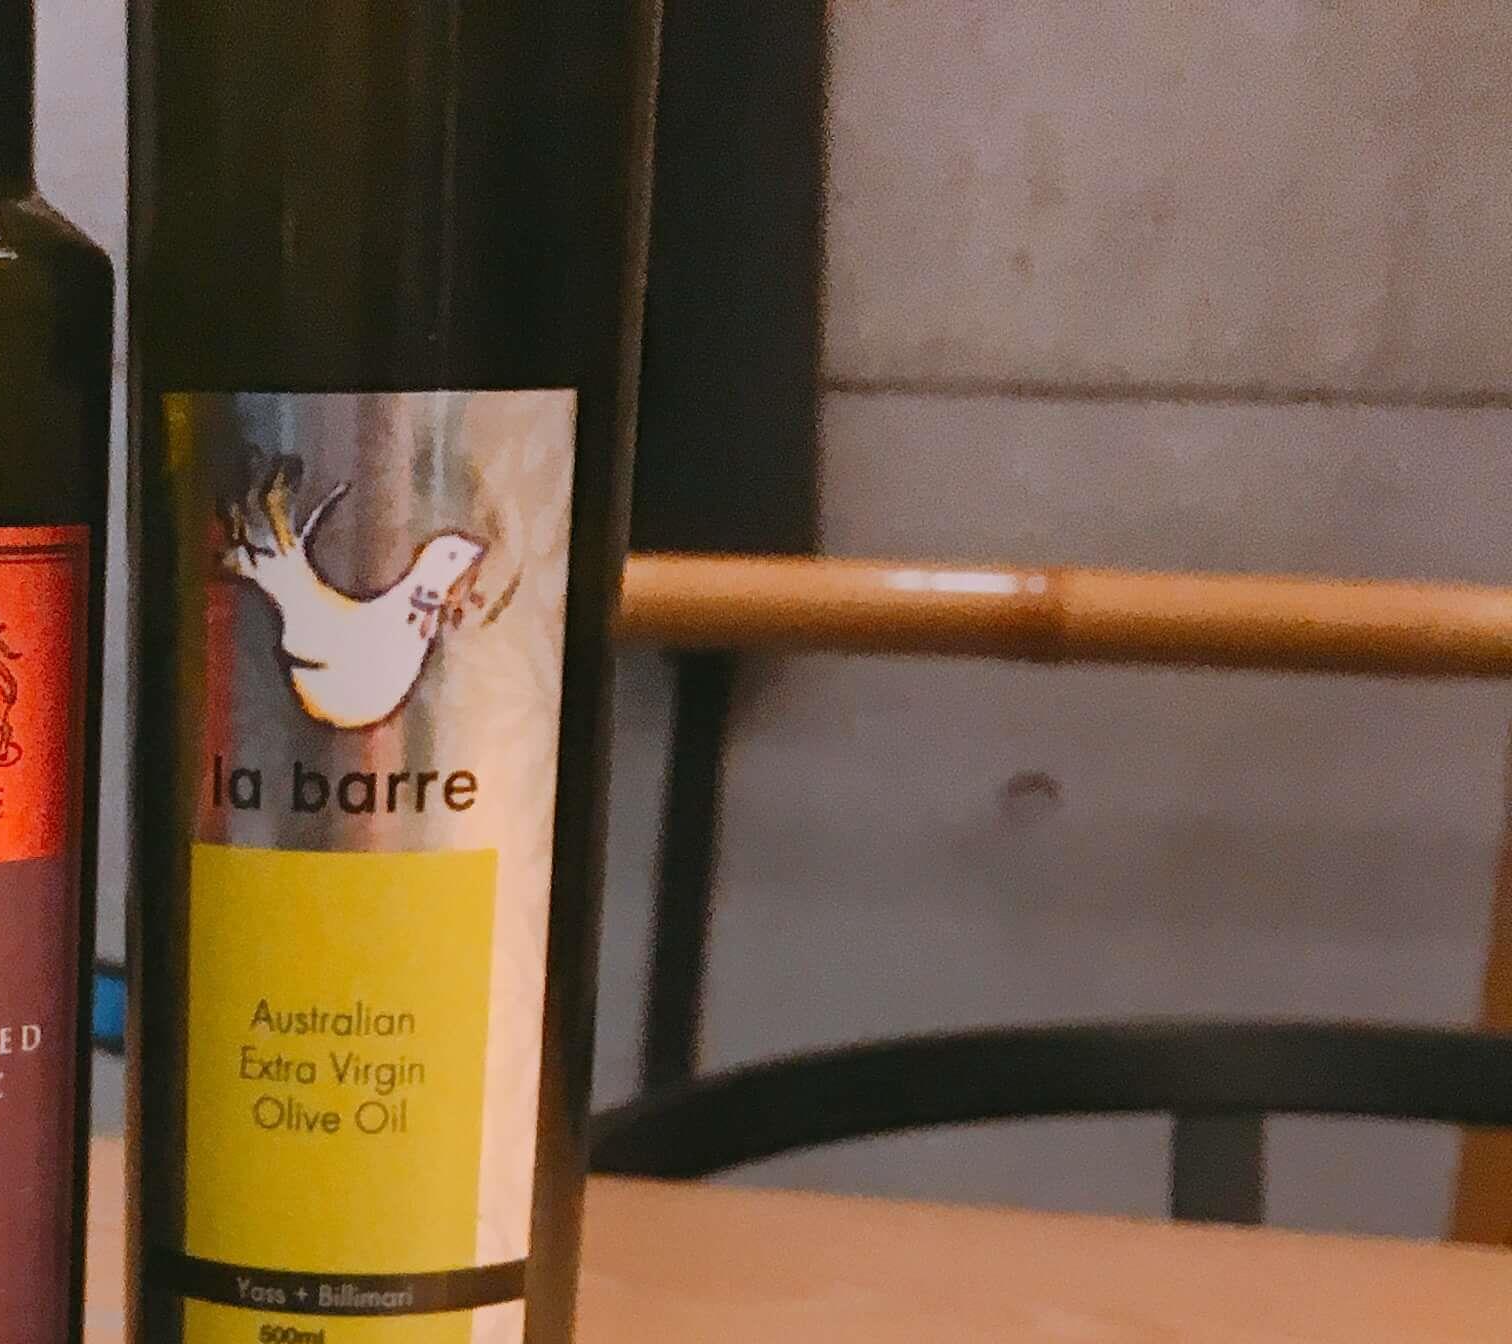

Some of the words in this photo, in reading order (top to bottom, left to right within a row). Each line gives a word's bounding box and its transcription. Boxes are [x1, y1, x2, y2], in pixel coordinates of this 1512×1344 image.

[212, 754, 263, 809] la
[293, 762, 479, 815] barre
[249, 998, 416, 1037] Australian
[239, 1045, 317, 1081] Extra
[330, 1051, 425, 1096] Virgin
[252, 1096, 341, 1134] Olive
[354, 1100, 408, 1134] Oil
[237, 1277, 285, 1306] Yass
[318, 1283, 414, 1309] Billimari
